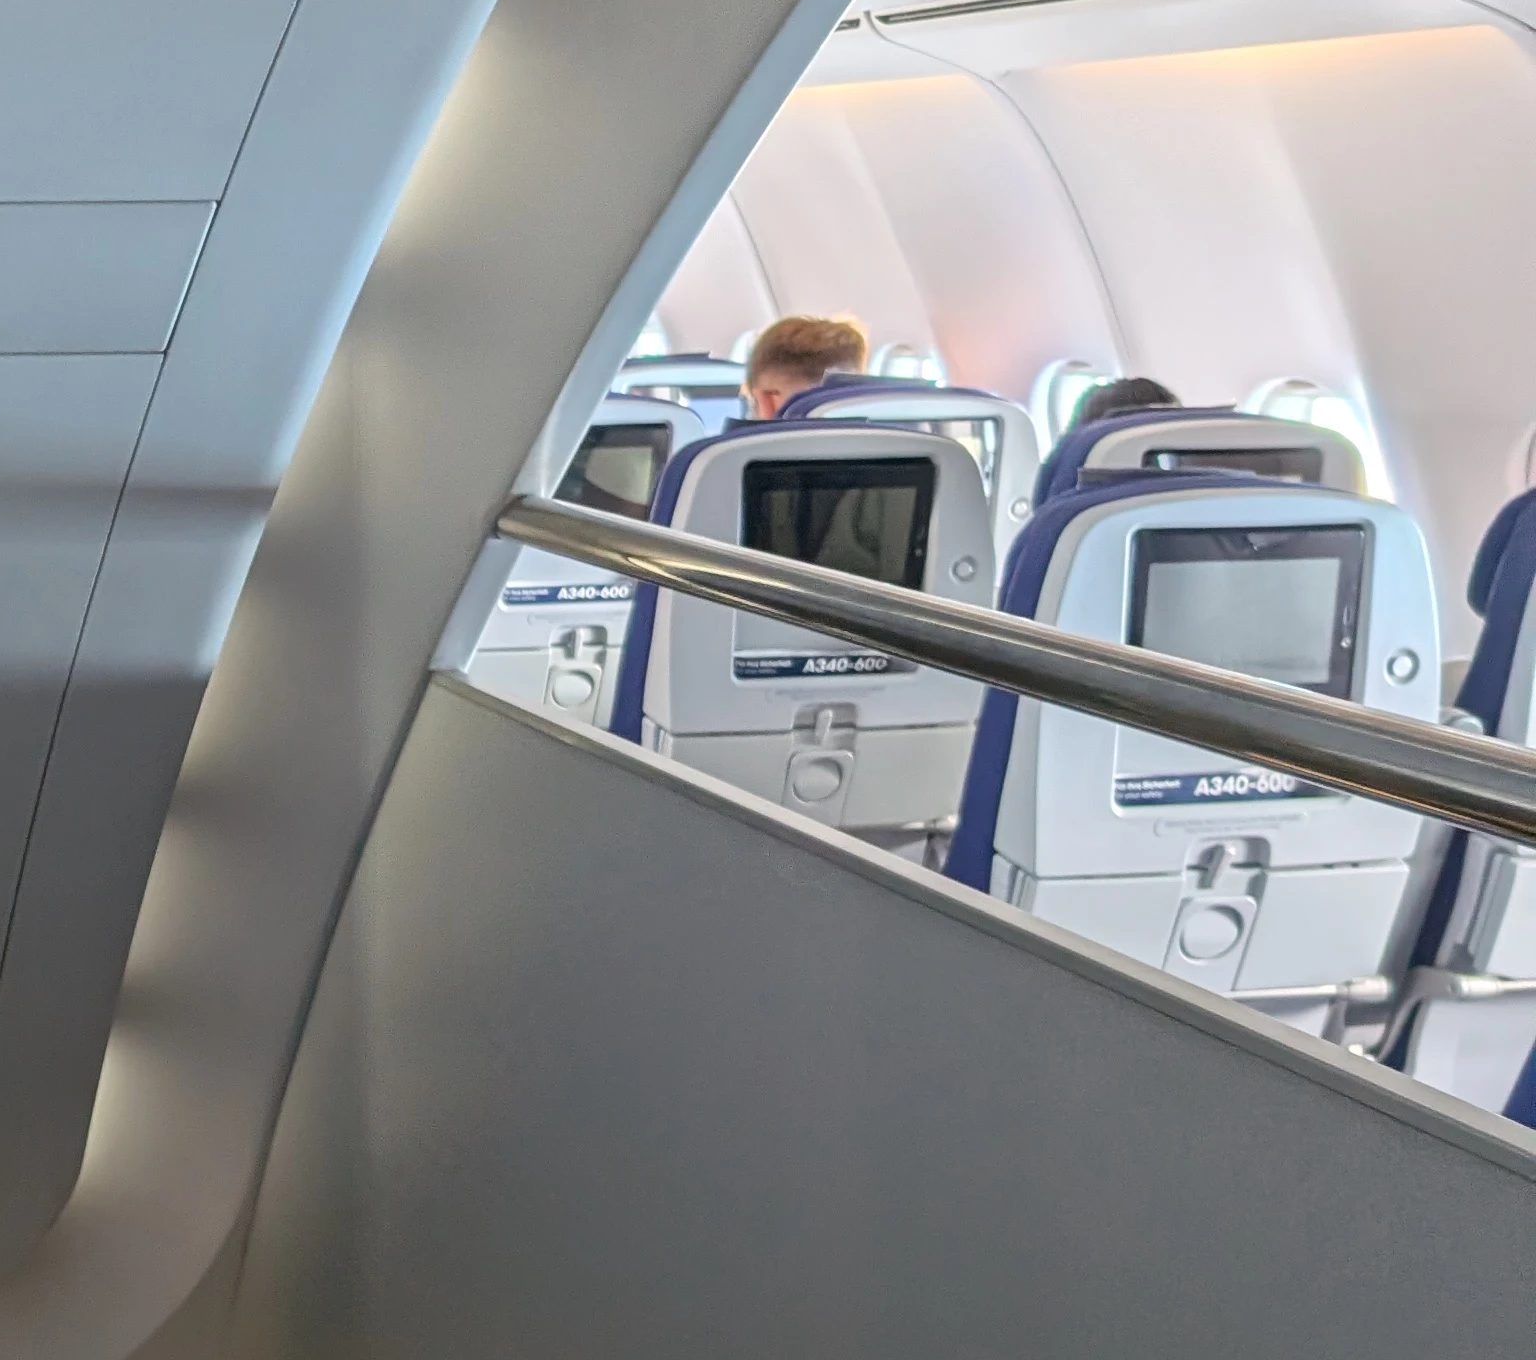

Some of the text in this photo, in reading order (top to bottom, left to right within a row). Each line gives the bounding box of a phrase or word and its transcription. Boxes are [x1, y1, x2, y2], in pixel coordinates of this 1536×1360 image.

[557, 586, 630, 600] A340-600
[802, 657, 888, 674] A340-600
[1193, 774, 1296, 798] A340-600
